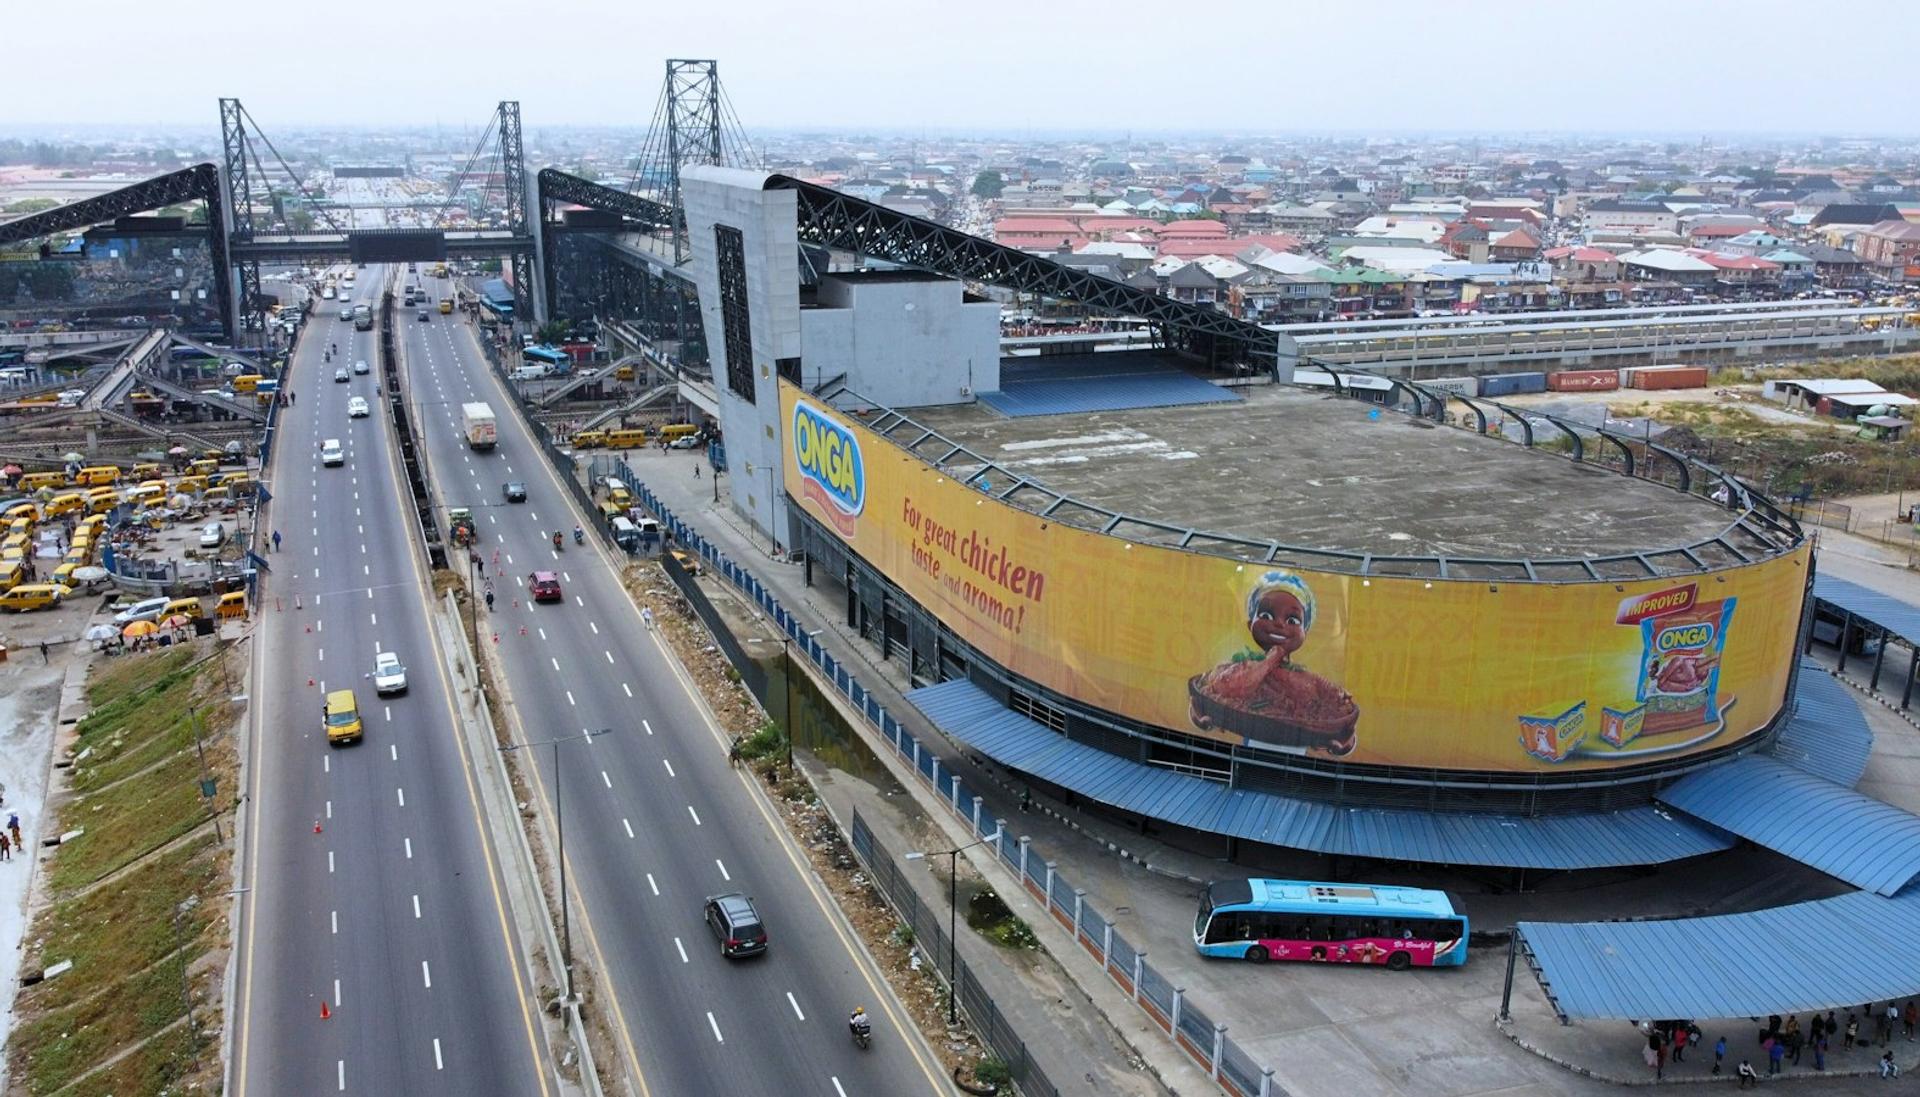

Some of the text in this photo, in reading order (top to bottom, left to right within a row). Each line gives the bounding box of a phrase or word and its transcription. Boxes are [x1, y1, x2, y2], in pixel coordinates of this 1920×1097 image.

[796, 411, 858, 502] ONGA
[903, 496, 1045, 602] For great chicken
[911, 539, 1026, 634] taste and aroma!
[1625, 590, 1689, 617] IMPROVED
[1661, 626, 1708, 648] ONGA
